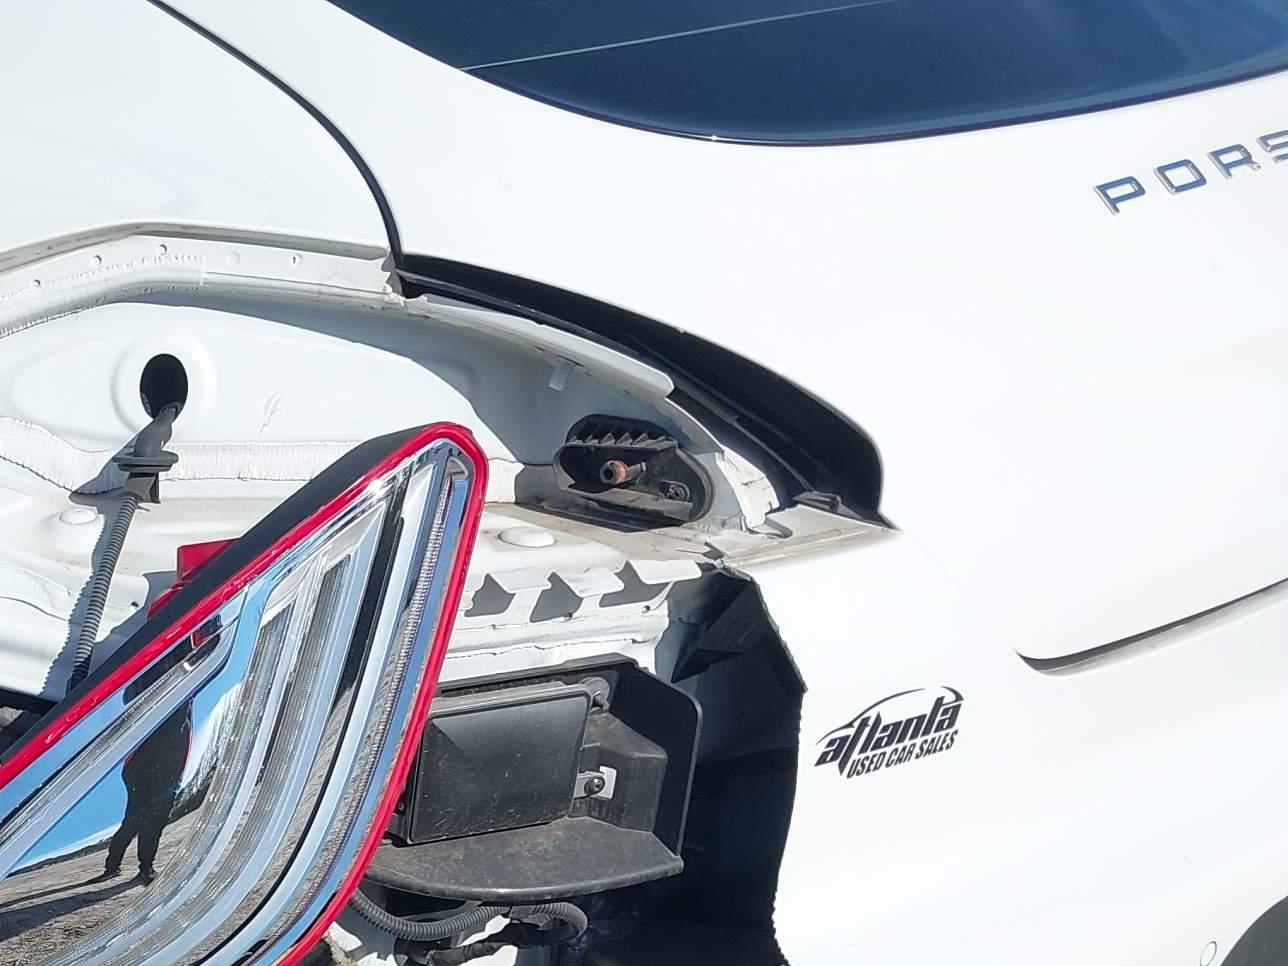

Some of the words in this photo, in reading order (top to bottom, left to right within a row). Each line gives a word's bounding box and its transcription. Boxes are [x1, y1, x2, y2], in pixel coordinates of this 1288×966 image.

[846, 751, 887, 779] USED
[885, 743, 917, 769] CAR
[915, 729, 959, 760] SALES
